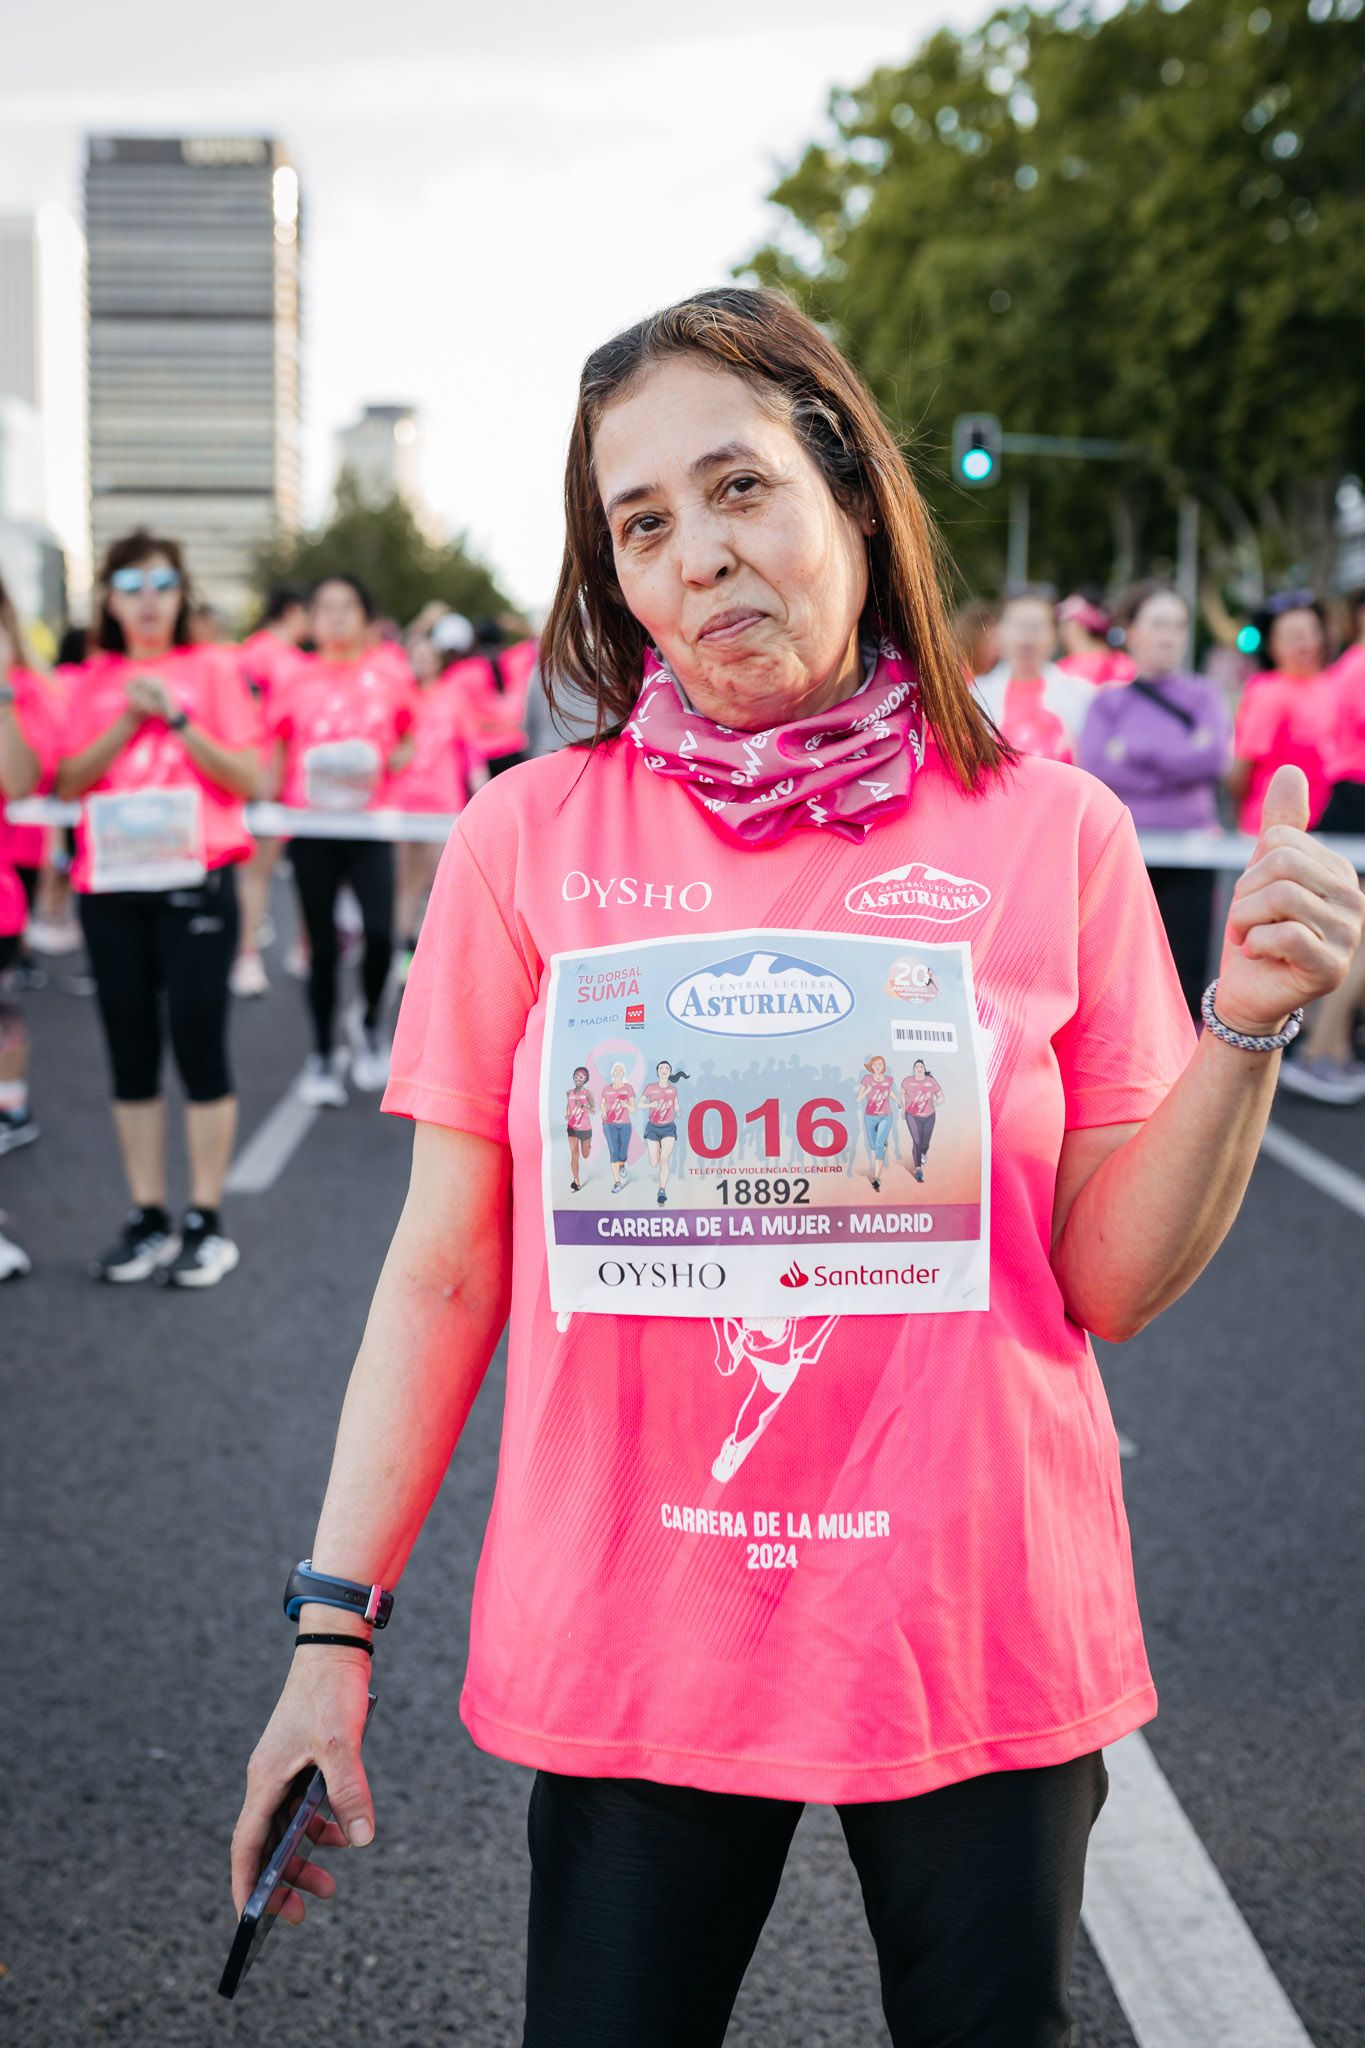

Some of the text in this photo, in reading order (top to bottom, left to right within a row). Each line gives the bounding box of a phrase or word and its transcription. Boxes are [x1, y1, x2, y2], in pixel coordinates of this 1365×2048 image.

[561, 870, 713, 913] OYSHO
[878, 881, 975, 894] CENTRAL LECHERA
[857, 890, 982, 911] ASTURIANA
[578, 966, 643, 985] TU DORSAL
[709, 980, 835, 992] CENTRAL LECHERA
[577, 979, 640, 1004] SUMA
[680, 986, 842, 1018] ASTURIANA
[580, 1014, 619, 1027] MADRID
[687, 1097, 849, 1160] 016
[689, 1165, 843, 1176] TELÉFONO VIOLENCIA DE GÉNERO
[716, 1178, 811, 1206] 18892
[597, 1212, 934, 1238] CARRERA DE LA MUJER MADRID
[598, 1261, 727, 1290] OYSHO
[814, 1264, 941, 1287] Santander
[661, 1503, 891, 1540] CARRERA DE LA MUJER
[746, 1543, 799, 1570] 2024
